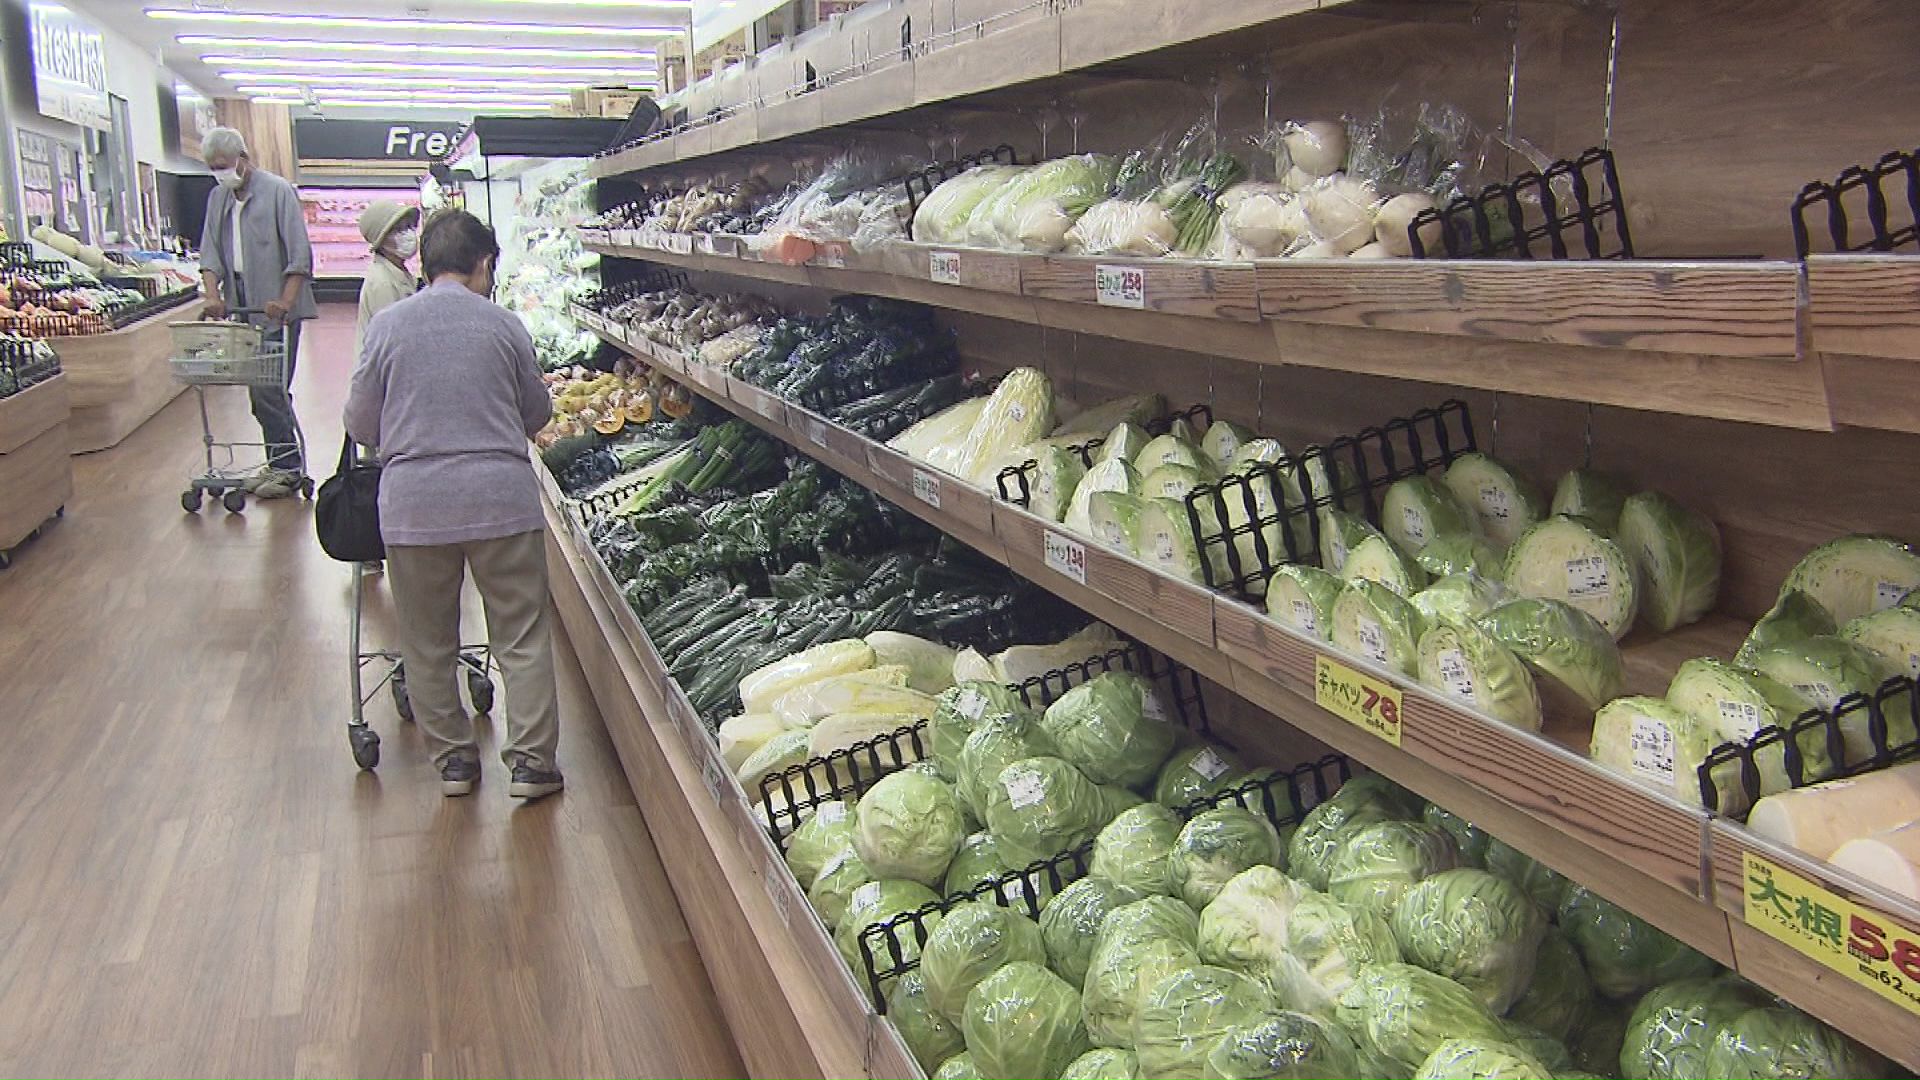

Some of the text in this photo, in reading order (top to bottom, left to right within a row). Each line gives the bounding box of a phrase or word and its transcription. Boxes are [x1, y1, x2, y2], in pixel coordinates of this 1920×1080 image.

[1121, 270, 1141, 293] 258
[1319, 671, 1360, 705] キャベツ
[1361, 684, 1399, 724] 78
[1749, 875, 1920, 984] 大根 58
